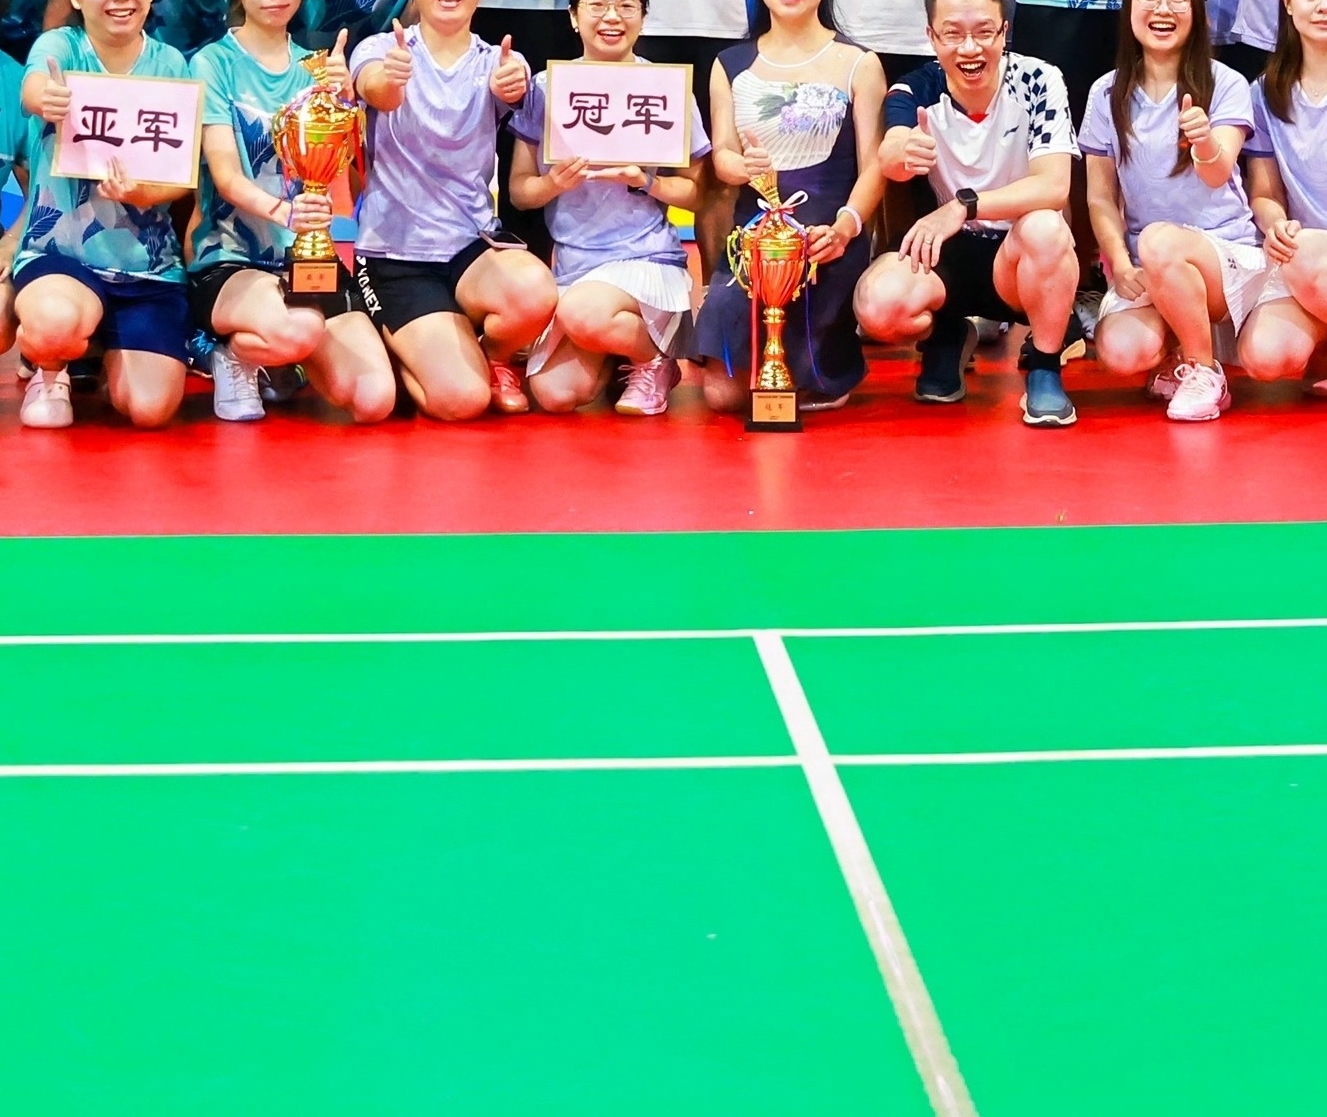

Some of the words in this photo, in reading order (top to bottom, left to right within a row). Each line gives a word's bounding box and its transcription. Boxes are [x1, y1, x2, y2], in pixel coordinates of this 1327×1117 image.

[72, 105, 183, 152] 亚军
[562, 91, 674, 135] 冠军
[357, 267, 382, 317] YONEX
